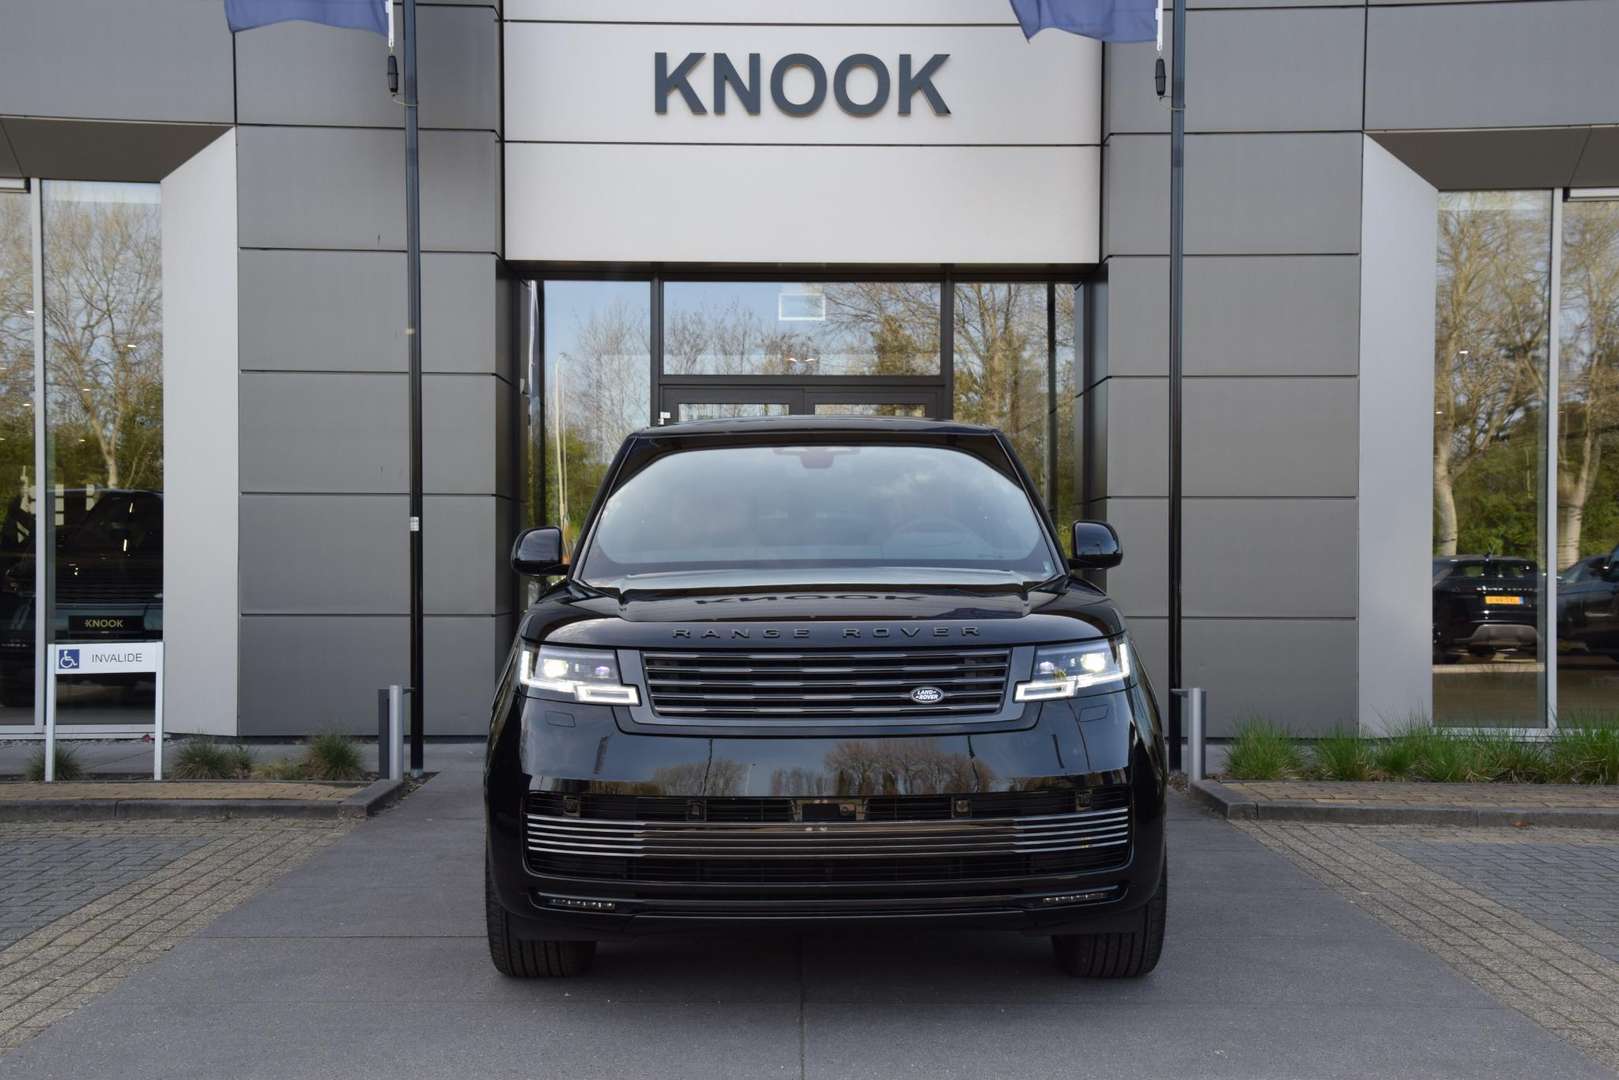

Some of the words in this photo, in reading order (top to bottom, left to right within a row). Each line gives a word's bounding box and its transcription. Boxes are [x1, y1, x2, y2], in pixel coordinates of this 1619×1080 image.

[655, 52, 951, 117] KNOOK
[85, 619, 123, 628] KNOOK
[672, 628, 811, 638] RANGE
[842, 626, 980, 638] ROVER
[91, 653, 143, 663] INVALIDE
